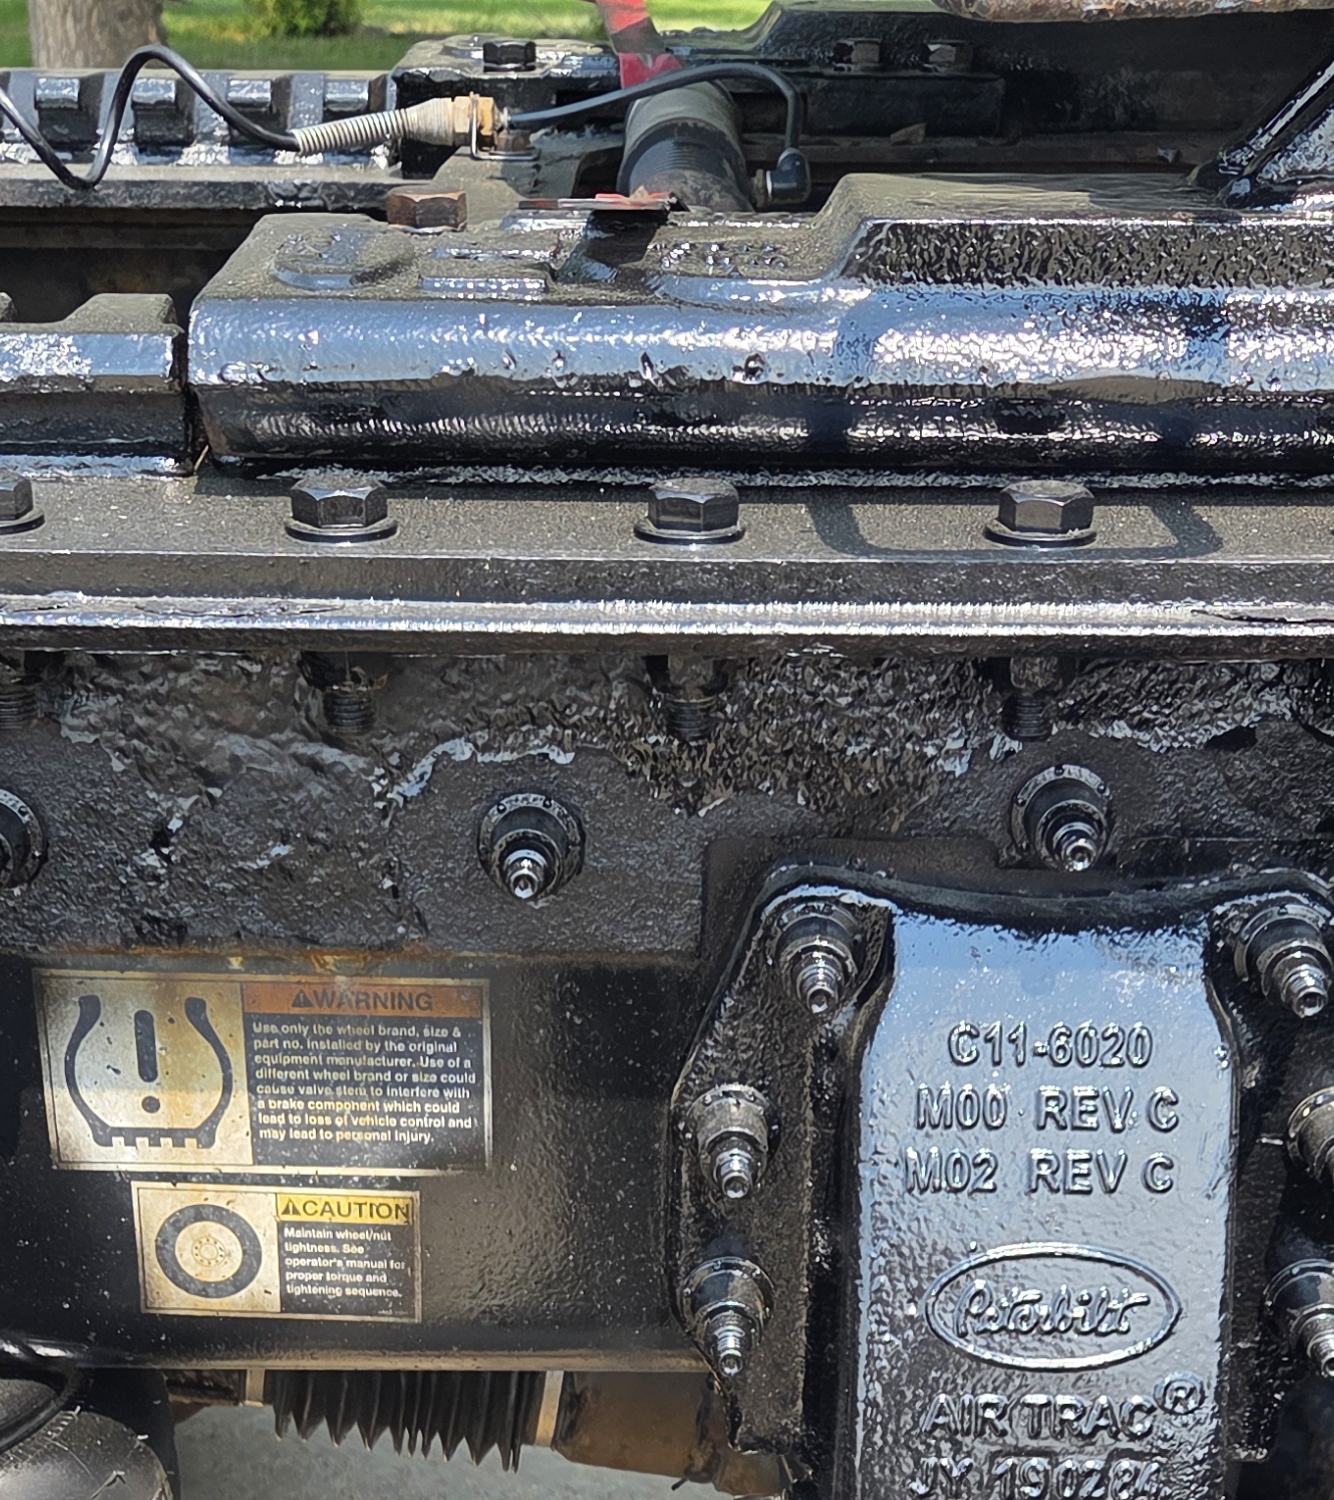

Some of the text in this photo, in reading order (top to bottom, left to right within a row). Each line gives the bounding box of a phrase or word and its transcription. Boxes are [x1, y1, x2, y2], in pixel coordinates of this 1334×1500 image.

[313, 989, 433, 1012] WARNING
[252, 1022, 277, 1033] Use
[281, 1022, 308, 1036] only
[313, 1023, 332, 1034] the
[336, 1023, 374, 1036] wheel
[378, 1024, 419, 1037] brand,
[423, 1025, 448, 1037] size
[253, 1036, 456, 1055] part no. installed by the original
[948, 1020, 1155, 1068] C11-6020
[254, 1052, 471, 1068] equipment manufacturer. Use of a
[255, 1066, 475, 1083] different wheel brand or size could
[256, 1082, 470, 1099] cause valve stem to interfere with
[258, 1098, 459, 1114] a brake component which could
[915, 1083, 1180, 1134] M00 REV C
[258, 1112, 471, 1128] lead to loss of vehicle control and
[259, 1128, 434, 1145] may lead to personal injury.
[905, 1147, 1175, 1196] M02 REV C
[302, 1199, 409, 1220] CAUTION
[284, 1227, 391, 1242] Maintain wheel/nut
[342, 1244, 364, 1254] See
[285, 1255, 405, 1270] operator's manual for
[285, 1271, 387, 1284] proper torque and
[286, 1285, 402, 1299] tightening sequence.
[919, 1394, 1010, 1439] AIR
